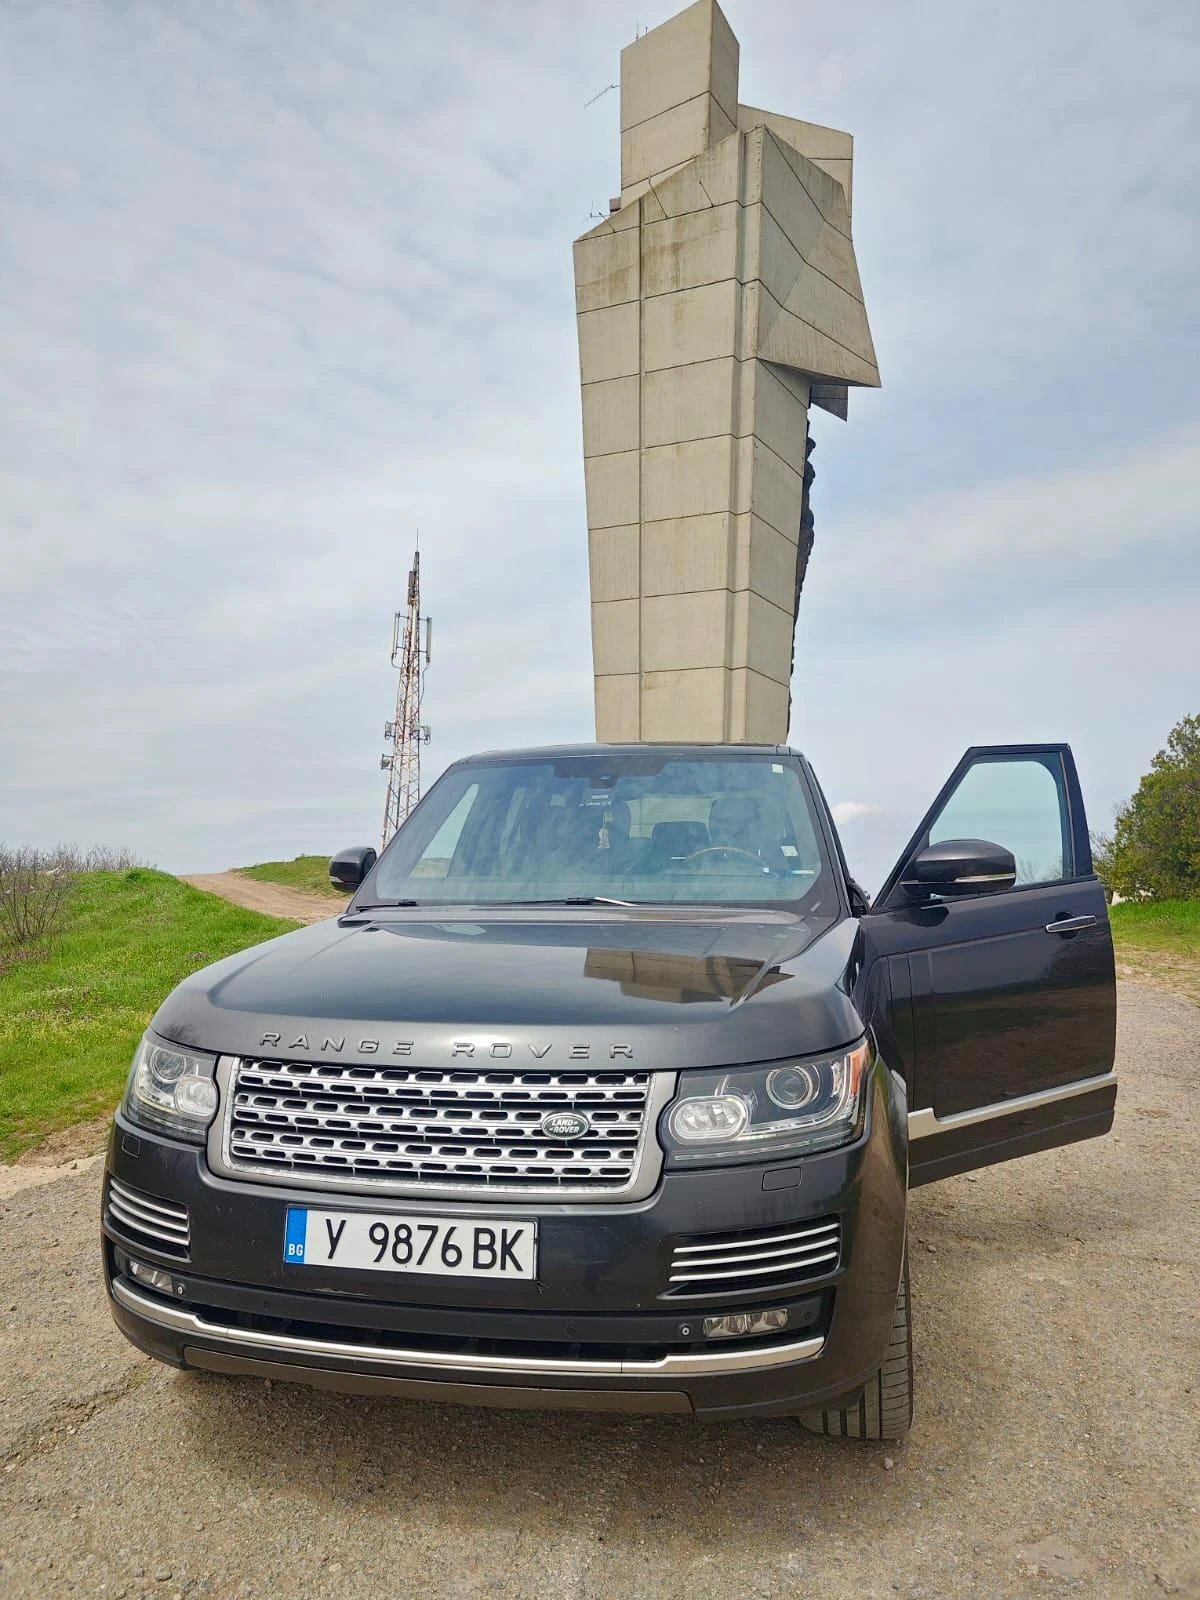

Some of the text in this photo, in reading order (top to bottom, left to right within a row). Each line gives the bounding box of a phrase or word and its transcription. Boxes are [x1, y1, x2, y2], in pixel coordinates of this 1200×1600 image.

[259, 1031, 634, 1060] RANGE ROVER
[553, 1126, 580, 1134] ROVER
[288, 1243, 304, 1256] BG
